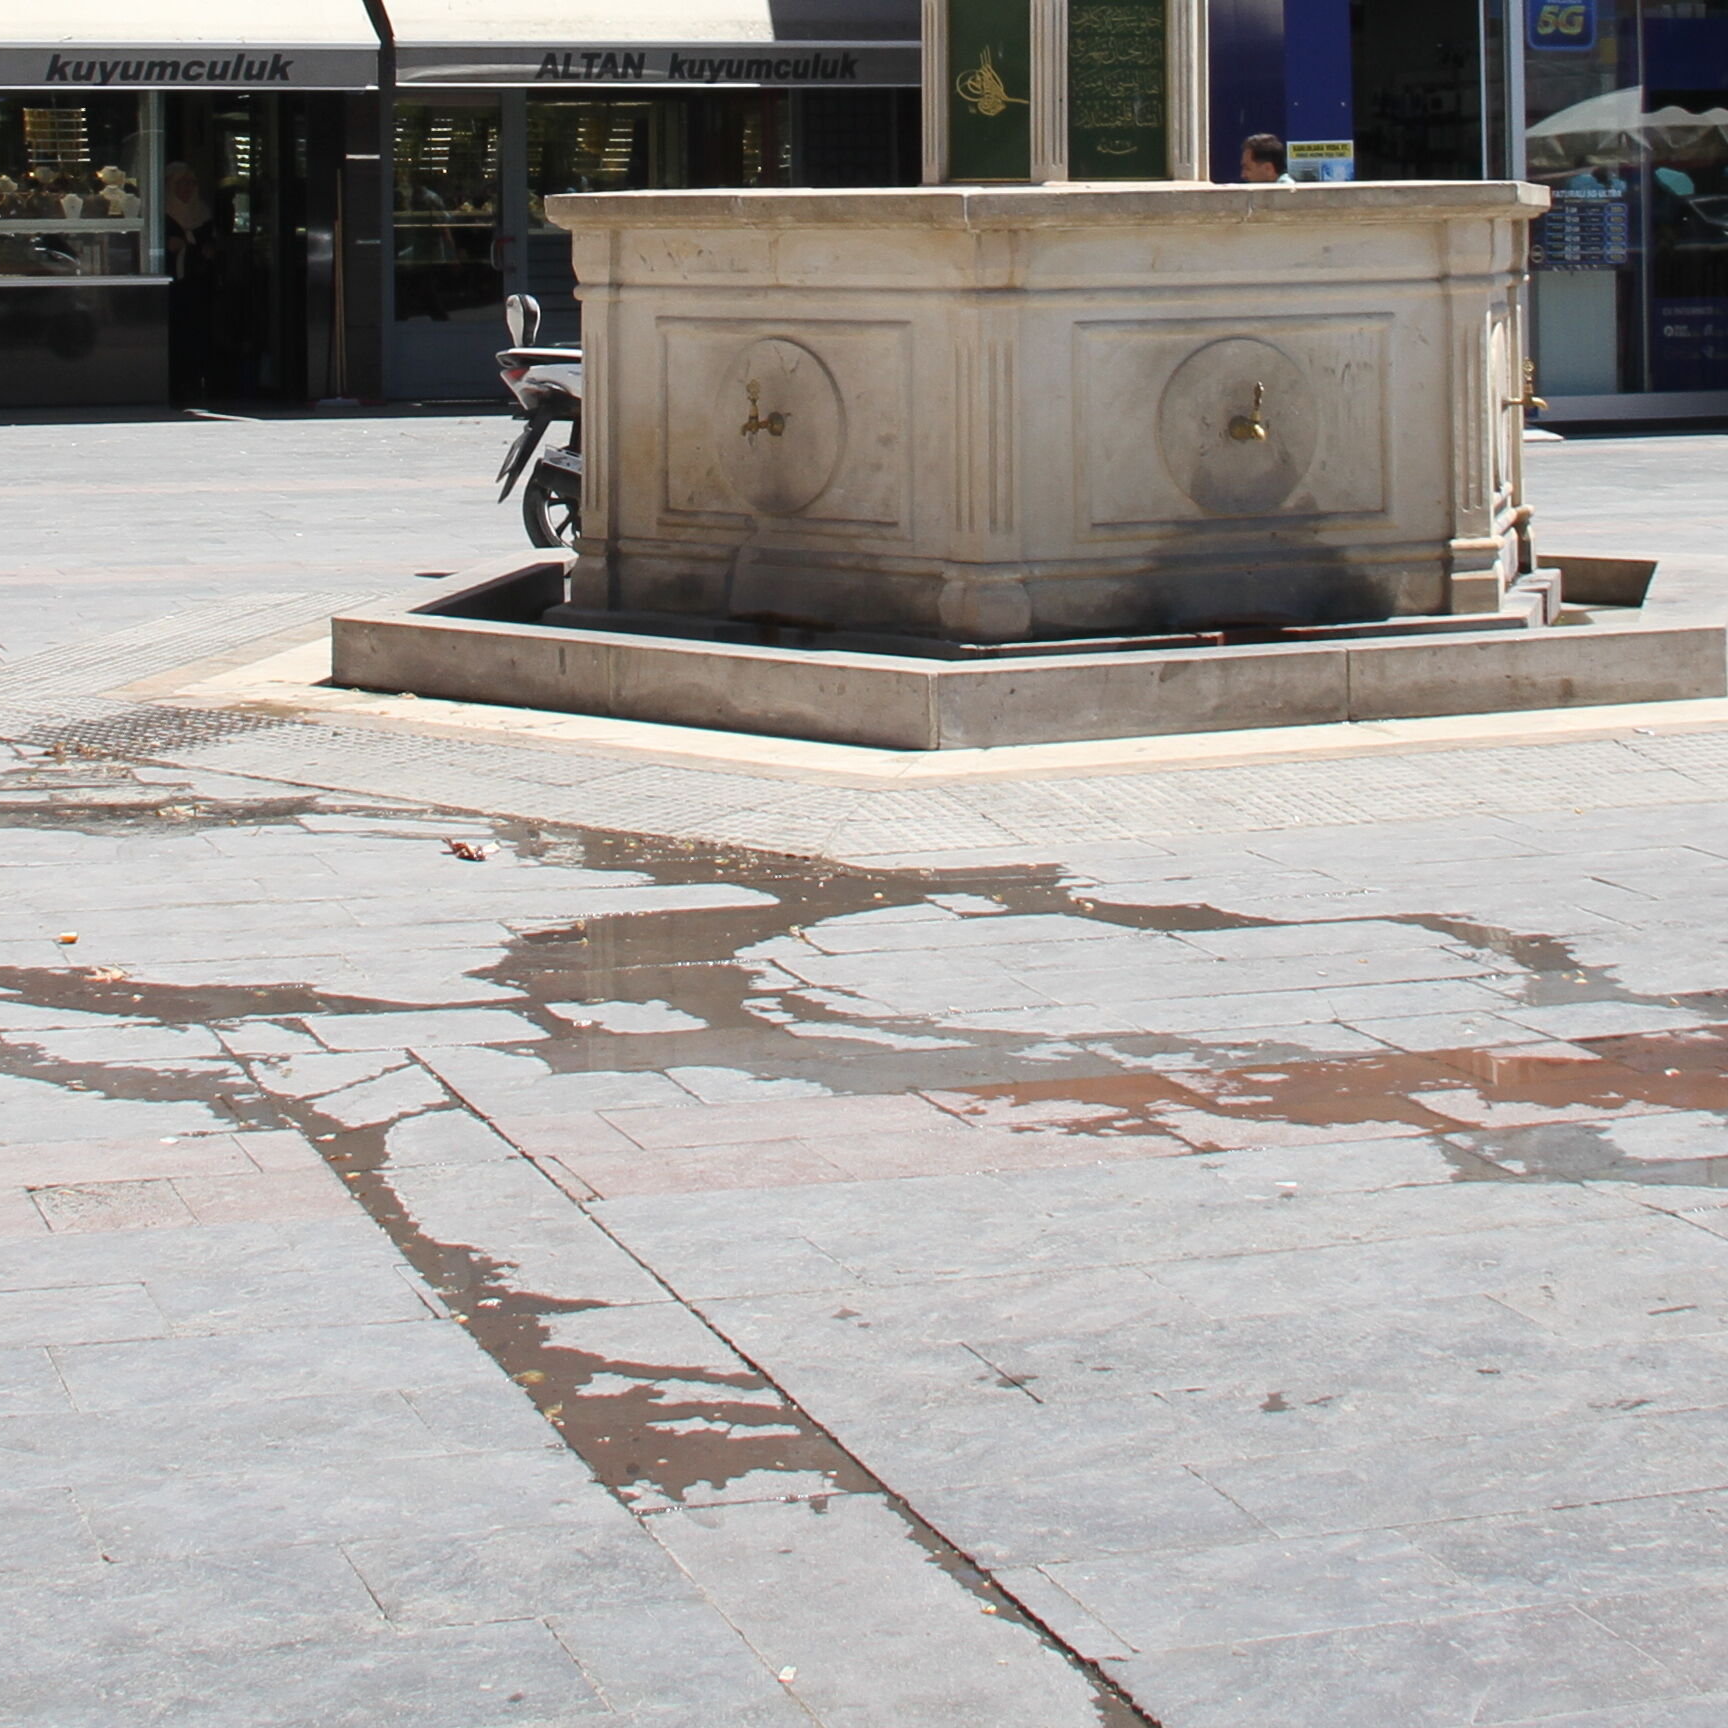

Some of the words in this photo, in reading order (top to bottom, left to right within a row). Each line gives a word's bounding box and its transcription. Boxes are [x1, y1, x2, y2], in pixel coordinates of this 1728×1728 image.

[1537, 4, 1587, 35] 5G
[45, 52, 294, 86] kuyumculuk
[535, 52, 646, 80] ALTAN
[668, 52, 860, 84] kuyumculuk
